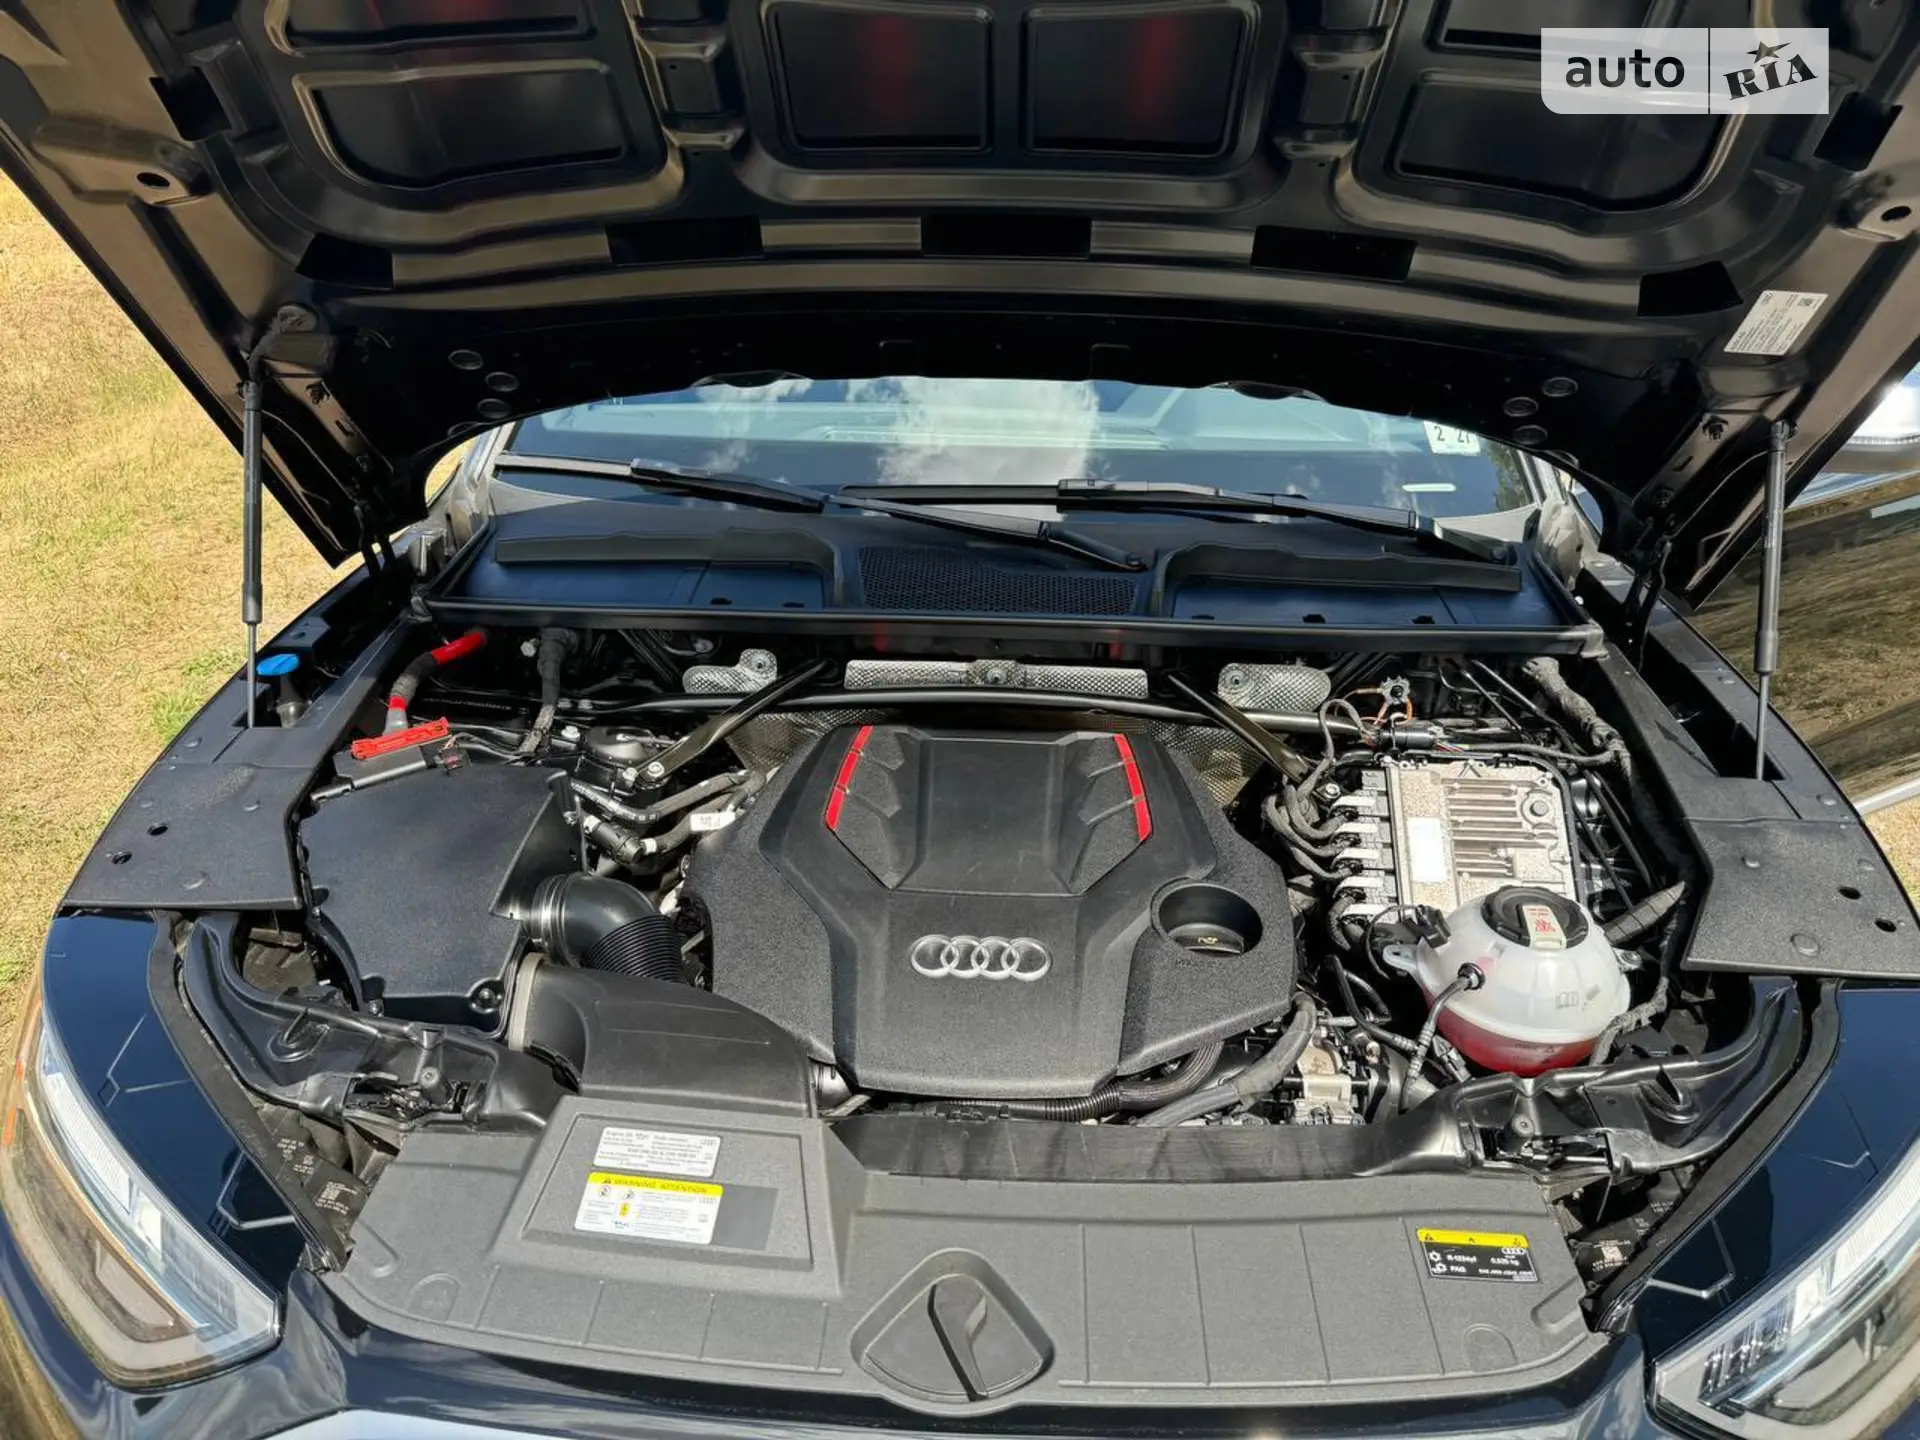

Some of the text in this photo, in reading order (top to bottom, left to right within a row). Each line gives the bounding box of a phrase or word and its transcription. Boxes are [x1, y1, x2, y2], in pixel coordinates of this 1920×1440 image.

[1433, 425, 1445, 442] 2
[614, 1178, 708, 1193] WARNING ATTENTION
